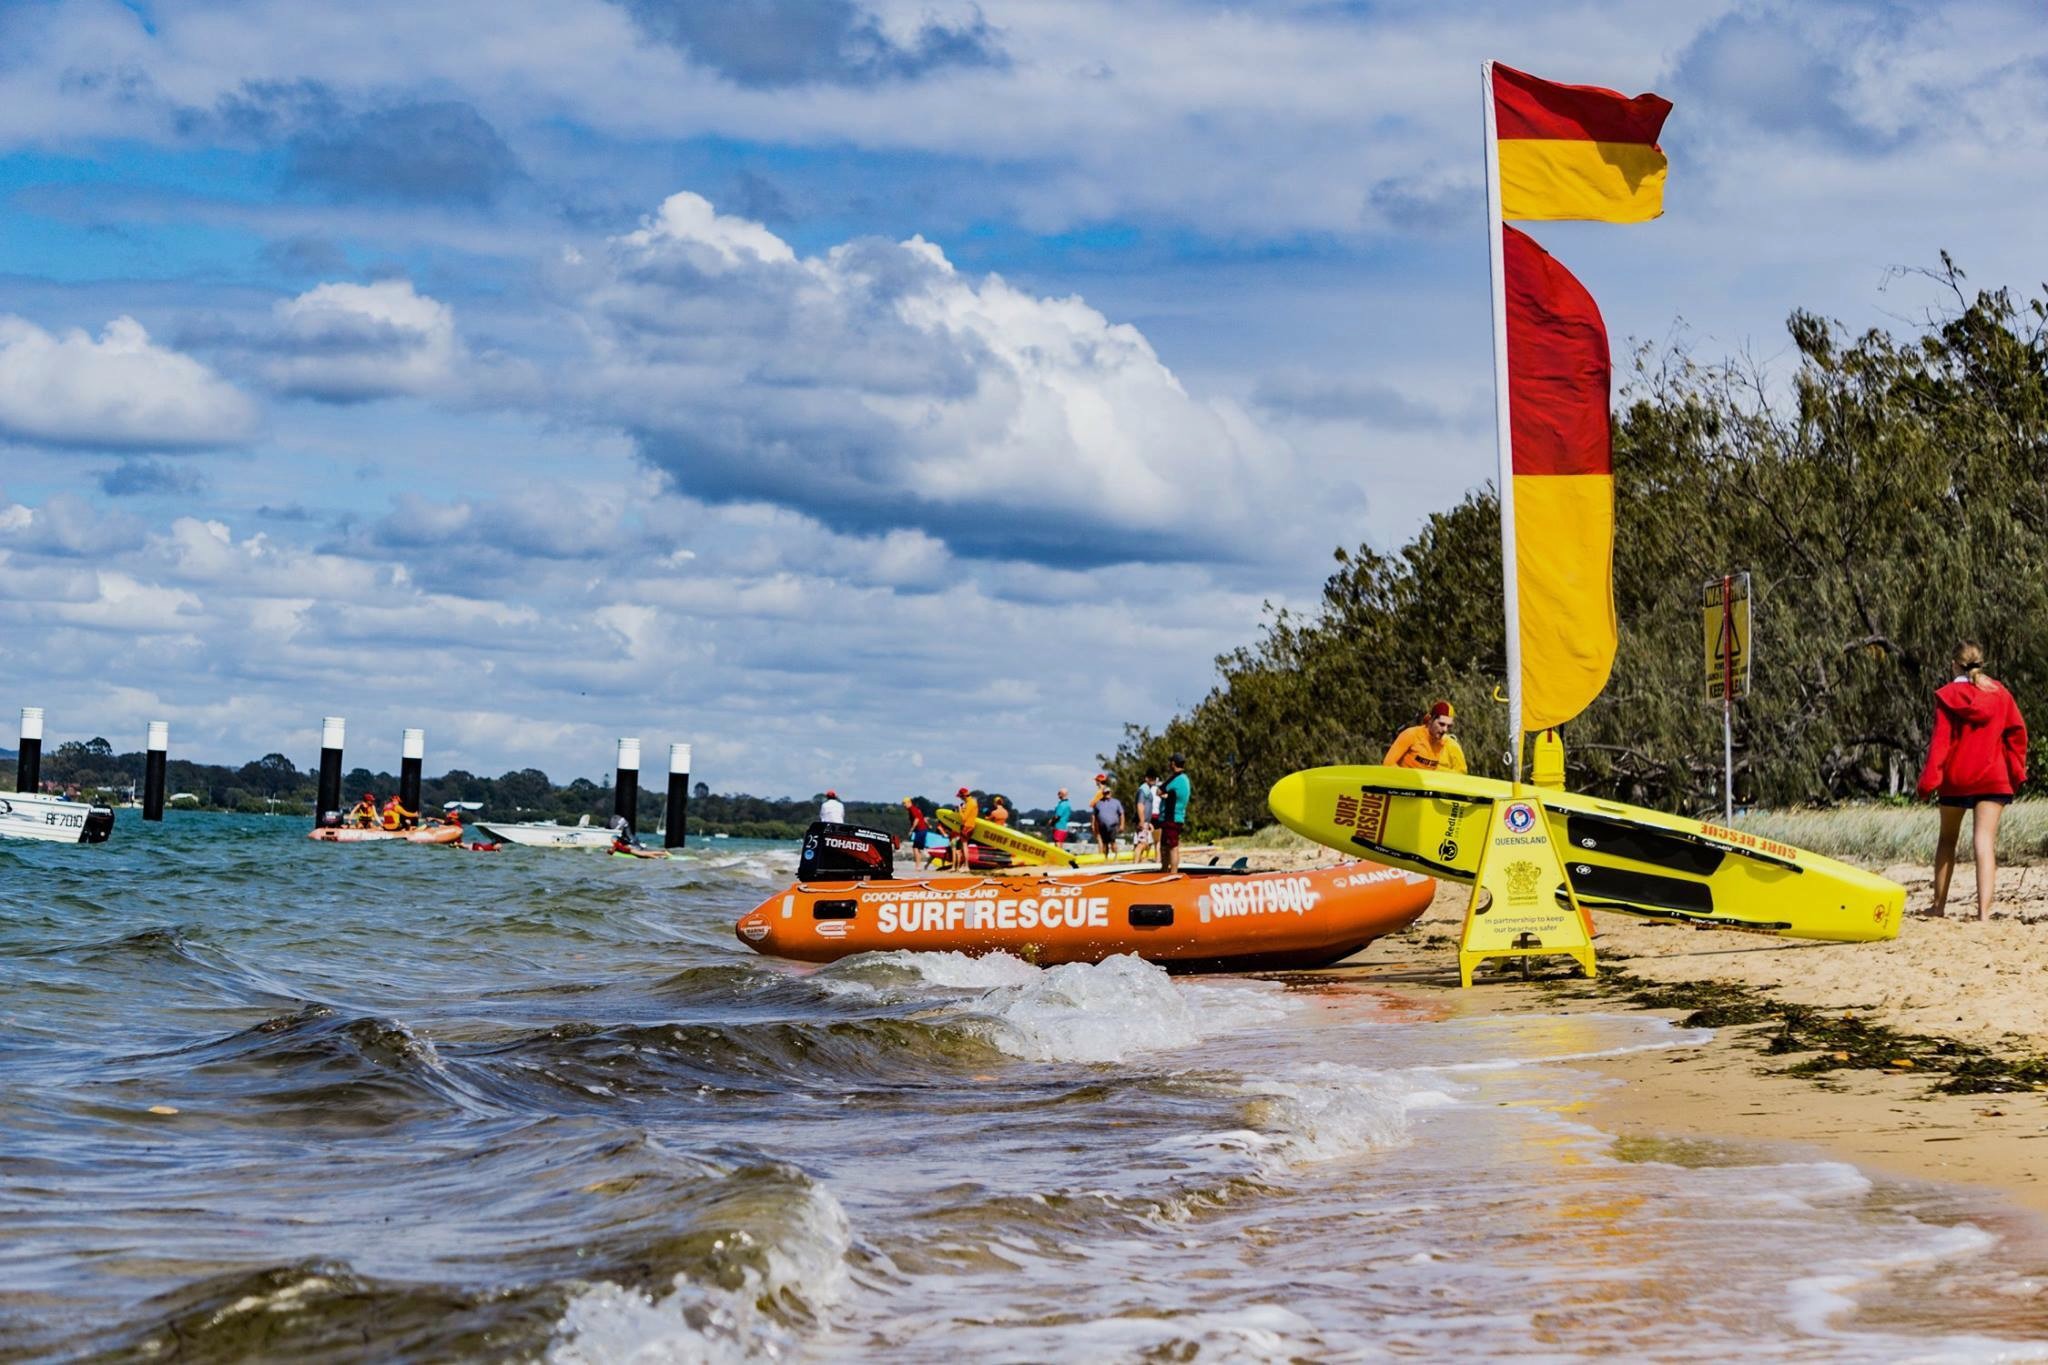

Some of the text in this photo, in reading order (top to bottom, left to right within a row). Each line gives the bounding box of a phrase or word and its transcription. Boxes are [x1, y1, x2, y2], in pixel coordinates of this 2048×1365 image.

[1334, 793, 1359, 827] SURF
[1355, 792, 1383, 840] RESCUE
[1445, 802, 1460, 837] Redland
[805, 835, 819, 849] 25
[824, 838, 870, 852] TOHATSU
[983, 830, 1048, 857] SURF RESCUE
[1495, 836, 1547, 845] QUEENSLAND
[1700, 823, 1756, 847] RESCUE
[1760, 840, 1797, 859] SURF
[956, 888, 999, 899] ISLAND
[1041, 886, 1083, 896] SLSC
[877, 897, 1109, 933] SURF RESCUE
[1493, 917, 1536, 925] partnership
